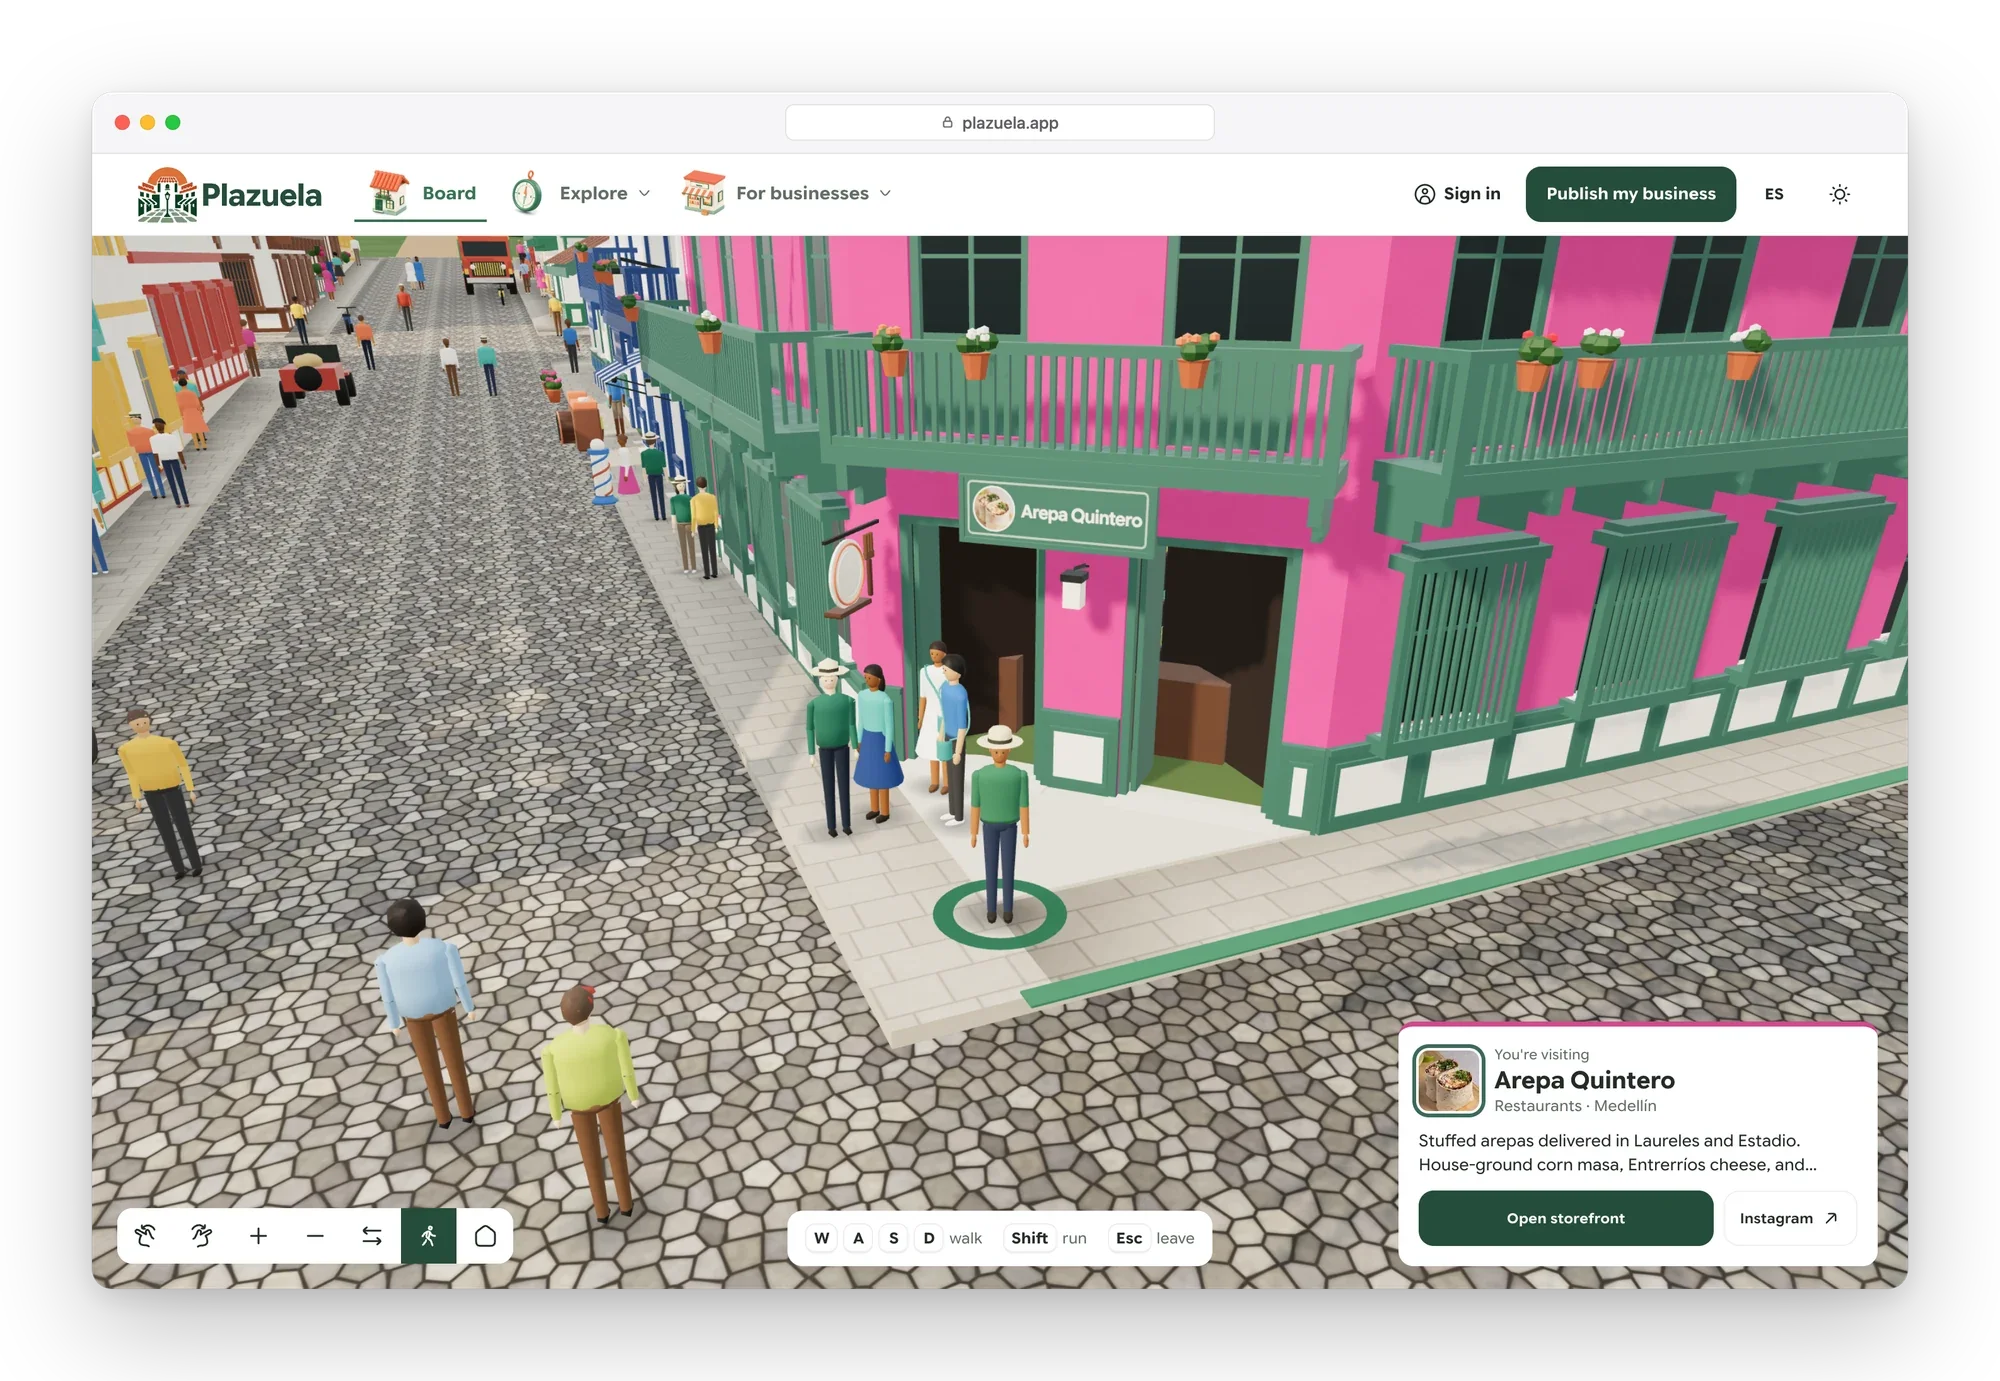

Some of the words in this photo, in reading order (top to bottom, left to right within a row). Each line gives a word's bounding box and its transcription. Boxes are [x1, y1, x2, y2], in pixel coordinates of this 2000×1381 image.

[962, 116, 1059, 132] plazuela.app
[203, 183, 322, 207] Plazuela
[423, 186, 476, 201] Board
[560, 186, 627, 204] Explore
[737, 186, 766, 201] For
[770, 185, 869, 201] businesses
[1444, 186, 1480, 204] Sign
[1485, 186, 1500, 201] in
[1547, 186, 1608, 201] Publish
[1613, 190, 1638, 204] my
[1642, 186, 1716, 201] business
[1765, 187, 1784, 201] ES
[1021, 504, 1068, 524] Arepa
[1071, 508, 1143, 528] Quintero
[1495, 1049, 1537, 1061] You're
[1541, 1049, 1589, 1063] visiting
[1494, 1071, 1564, 1094] Arepa
[1571, 1070, 1675, 1090] Quintero
[1495, 1100, 1582, 1112] Restaurants
[1594, 1099, 1657, 1112] Medellín
[1419, 1134, 1476, 1148] Stuffed
[1481, 1137, 1534, 1151] arepas
[1538, 1134, 1611, 1148] delivered
[1616, 1134, 1629, 1148] in
[1634, 1134, 1699, 1148] Laureles
[1704, 1134, 1733, 1148] and
[1738, 1134, 1800, 1148] Estadio.
[1419, 1158, 1532, 1174] House-ground
[1537, 1160, 1572, 1172] corn
[1578, 1160, 1624, 1173] masa,
[1628, 1158, 1705, 1172] Entrerríos
[1710, 1158, 1770, 1173] cheese,
[1775, 1158, 1817, 1172] and...
[1507, 1213, 1547, 1227] Open
[1551, 1213, 1625, 1225] storefront
[1740, 1213, 1813, 1228] Instagram
[814, 1232, 830, 1244] W
[853, 1232, 864, 1244] A
[889, 1232, 899, 1244] S
[924, 1232, 935, 1244] D
[949, 1231, 982, 1245] walk
[1011, 1231, 1048, 1245] Shift
[1063, 1234, 1087, 1245] run
[1116, 1231, 1142, 1245] Esc
[1157, 1231, 1195, 1245] leave
